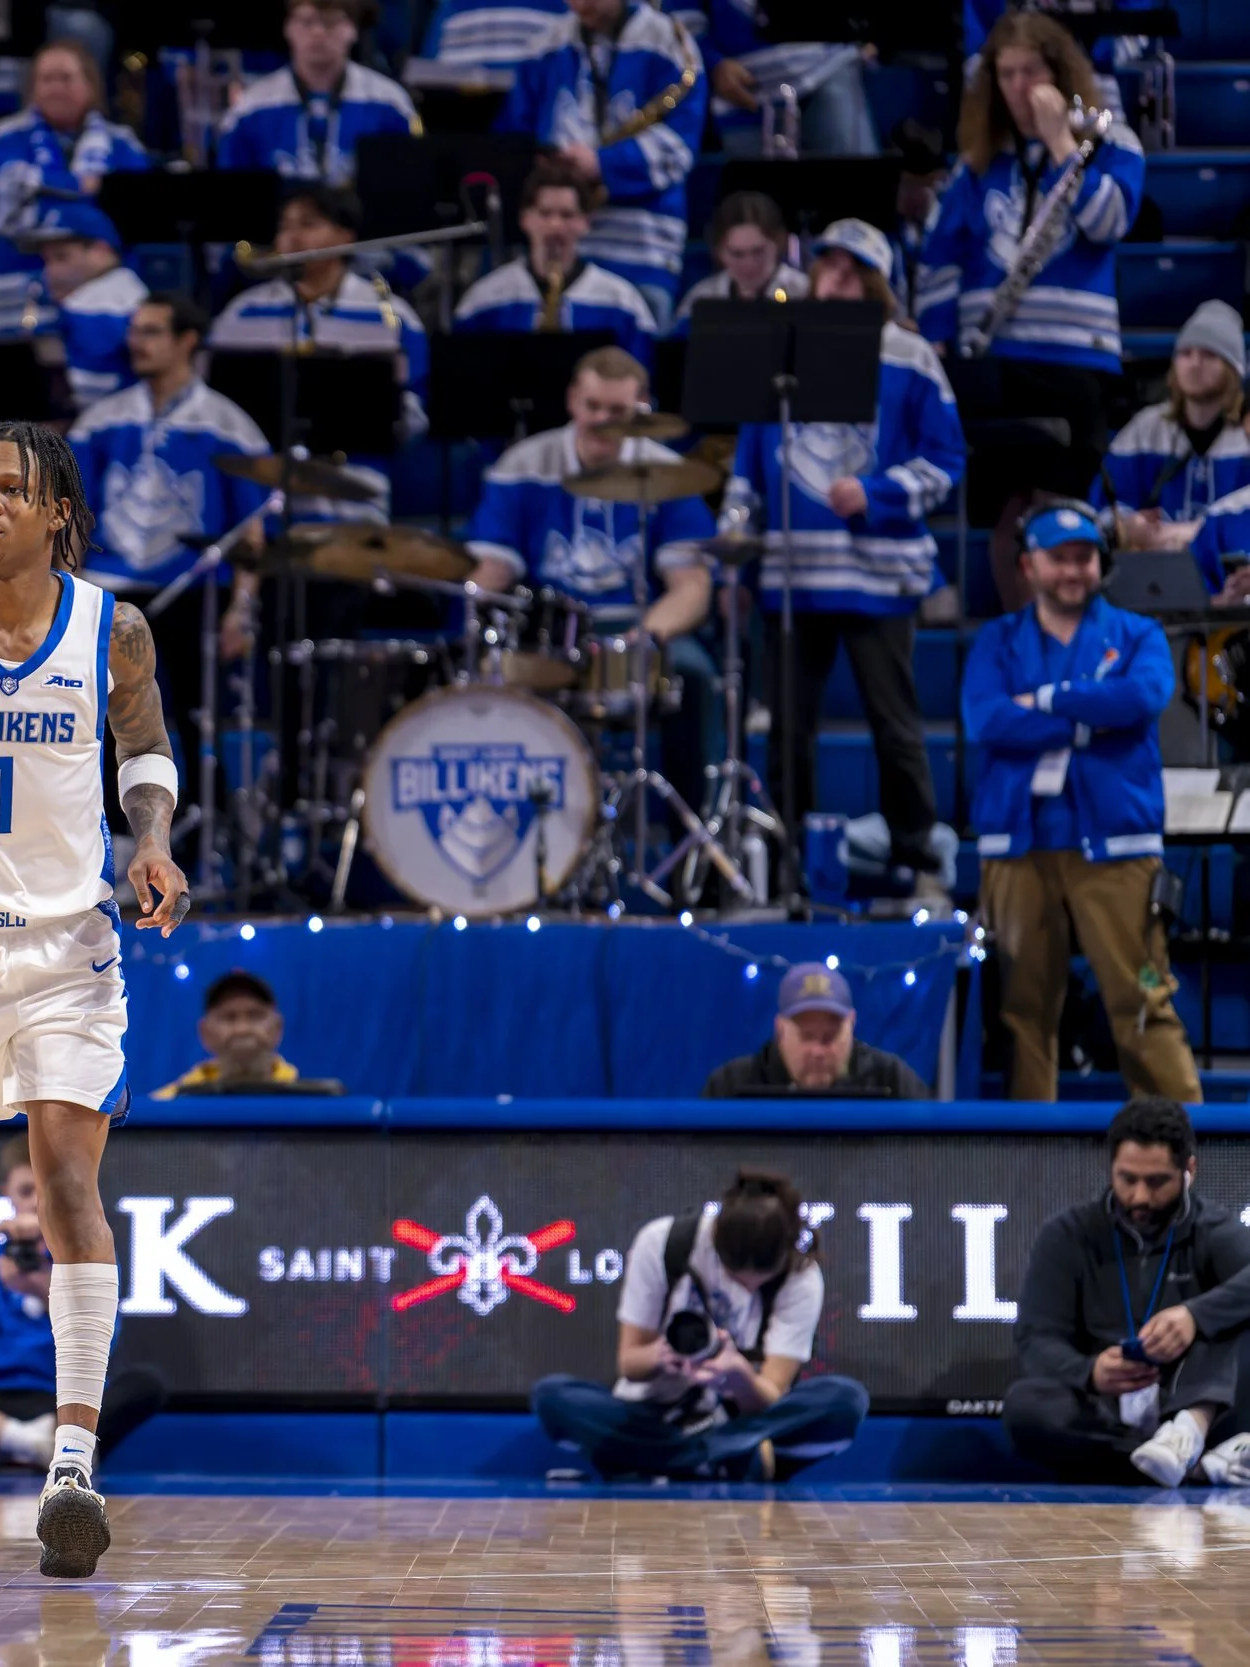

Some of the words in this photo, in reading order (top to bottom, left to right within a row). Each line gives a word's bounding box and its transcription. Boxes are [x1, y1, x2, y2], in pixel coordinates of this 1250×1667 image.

[399, 760, 561, 806] BILLIKENS
[258, 1246, 396, 1283] SAINT
[568, 1248, 624, 1285] LO
